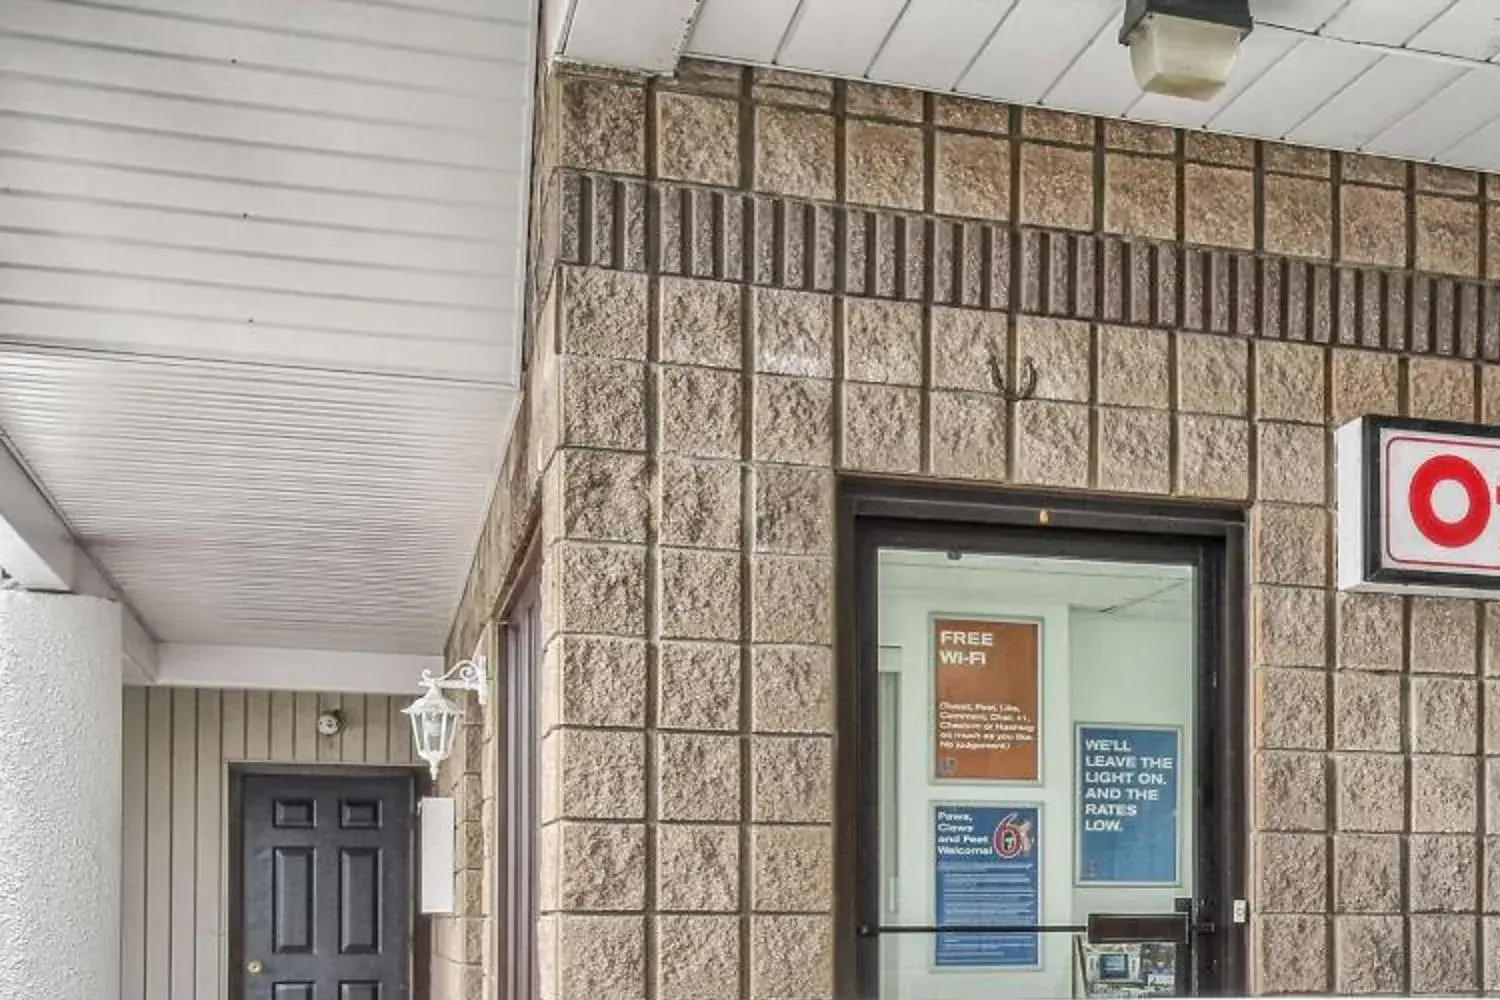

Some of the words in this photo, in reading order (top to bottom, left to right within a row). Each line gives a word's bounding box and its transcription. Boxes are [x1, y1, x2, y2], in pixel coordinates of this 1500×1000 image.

[940, 631, 993, 647] FREE
[939, 650, 987, 666] Wi-Fi
[1084, 738, 1132, 752] WE'LL
[1084, 755, 1137, 768] LEAVE
[1140, 756, 1174, 769] THE
[1084, 771, 1135, 784] LIGHT
[1138, 772, 1167, 785] ON.
[1084, 787, 1122, 799] AND
[1126, 788, 1160, 801] THE
[1084, 803, 1137, 817] RATES
[1084, 819, 1124, 833] LOW.
